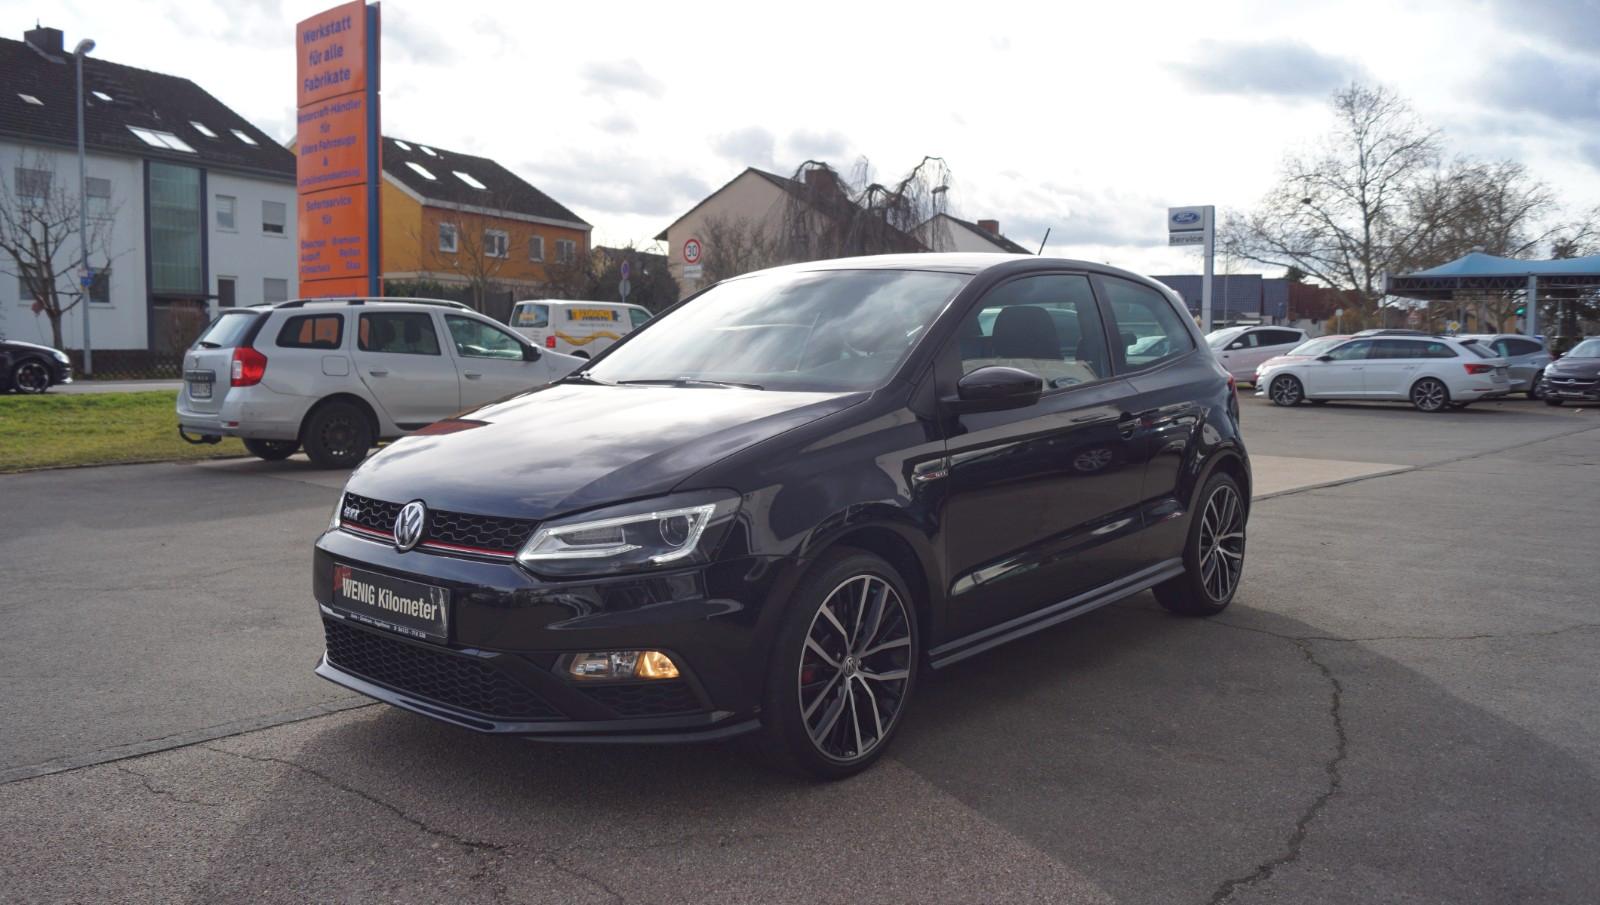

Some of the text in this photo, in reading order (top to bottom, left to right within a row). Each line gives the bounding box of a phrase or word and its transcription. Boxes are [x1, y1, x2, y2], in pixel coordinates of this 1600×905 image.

[303, 16, 351, 44] Werkstatt
[309, 44, 344, 66] für alle
[303, 68, 350, 93] Fabrikate
[305, 197, 352, 211] Sofortservice
[687, 244, 698, 257] 30
[1169, 236, 1204, 244] Service
[342, 577, 375, 606] WENIG
[378, 587, 438, 621] Kilometer
